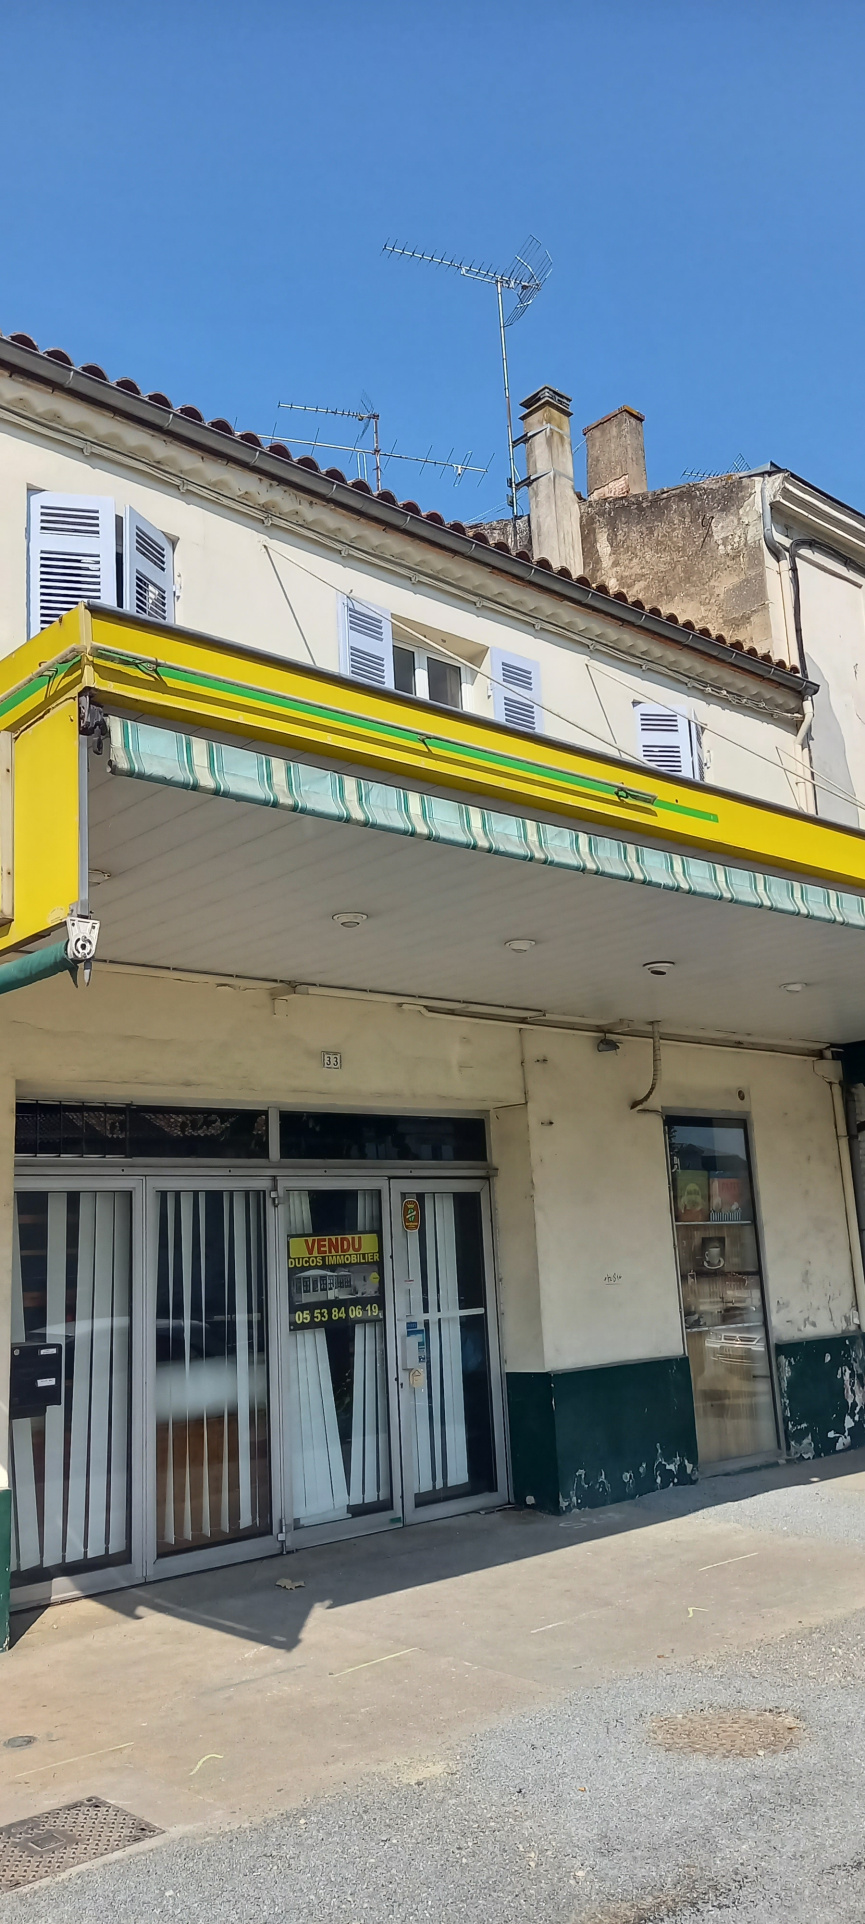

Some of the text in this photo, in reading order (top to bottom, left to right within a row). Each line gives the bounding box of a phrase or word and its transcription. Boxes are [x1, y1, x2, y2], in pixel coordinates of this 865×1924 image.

[326, 1056, 339, 1067] 33
[304, 1236, 362, 1255] VENDU
[288, 1253, 380, 1267] DUCOS IMMOBILIER
[295, 1303, 379, 1324] 05 53 84 06 19
